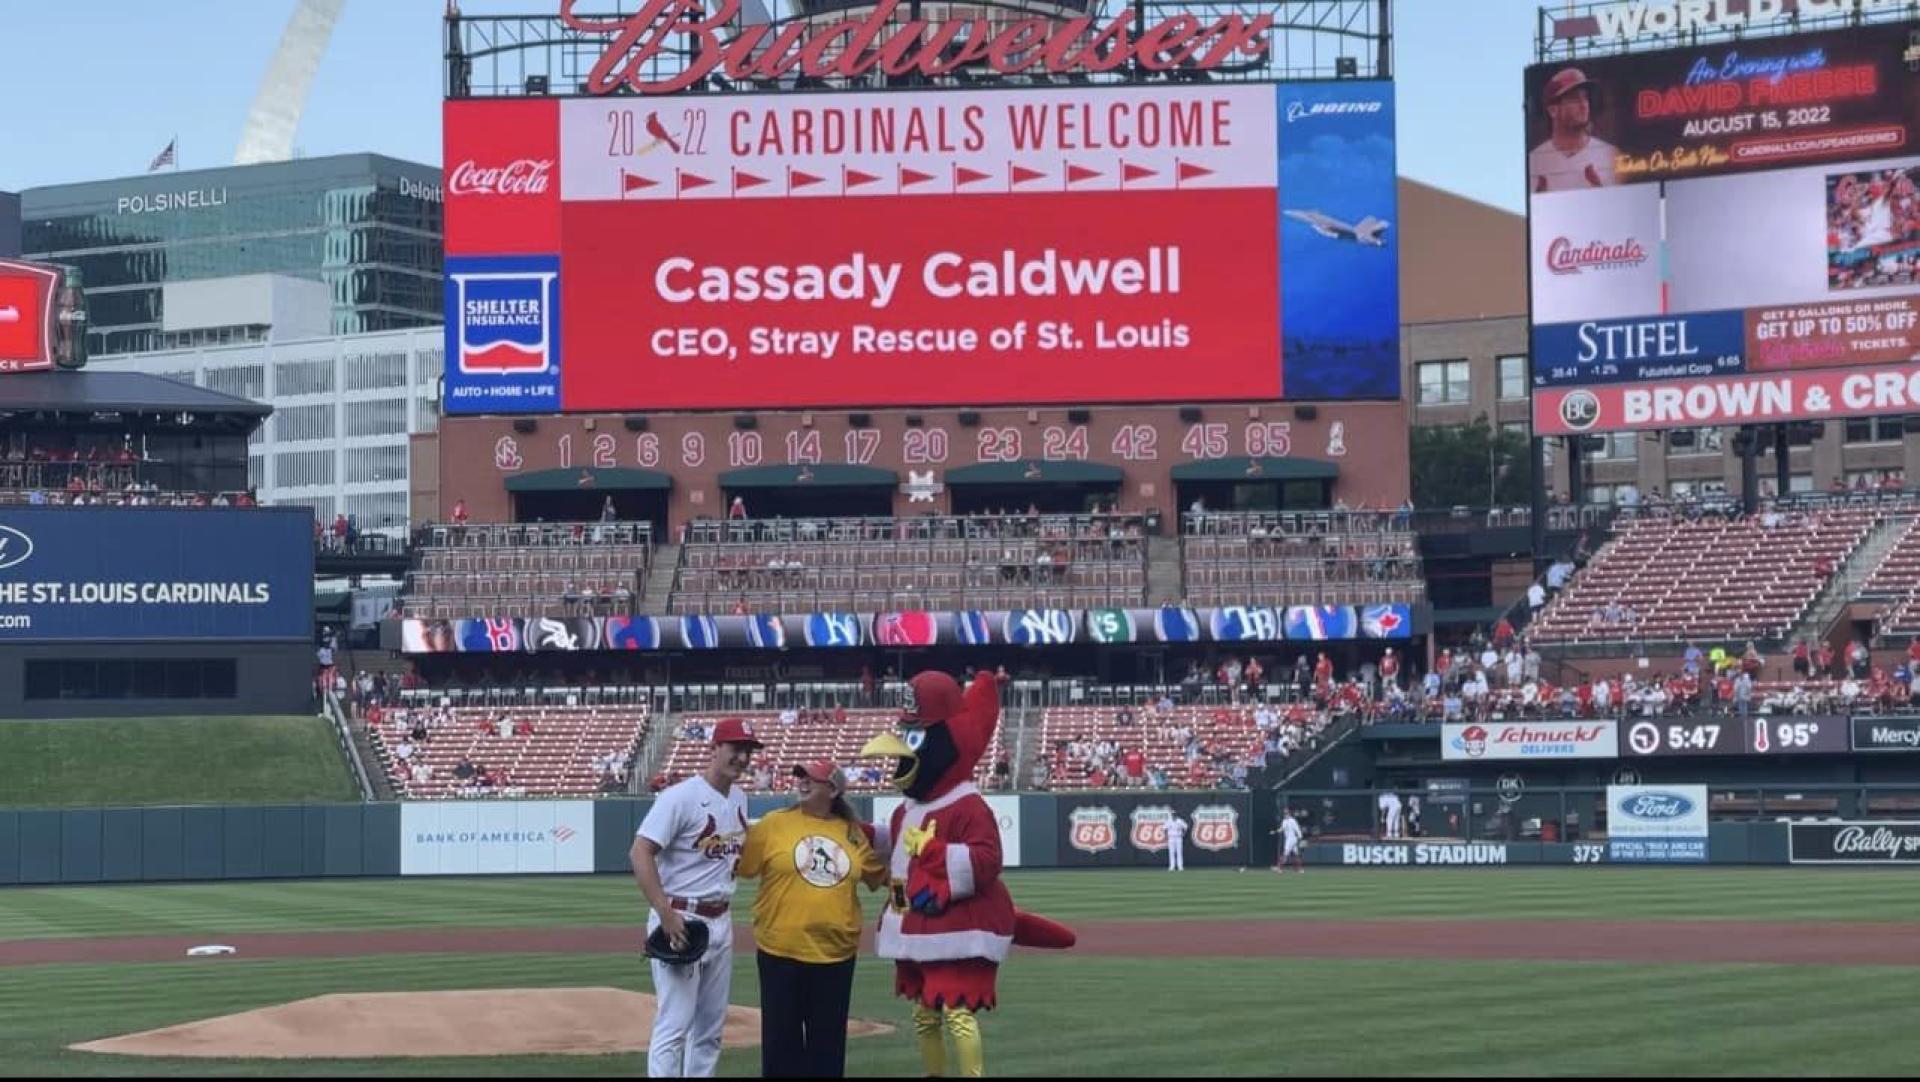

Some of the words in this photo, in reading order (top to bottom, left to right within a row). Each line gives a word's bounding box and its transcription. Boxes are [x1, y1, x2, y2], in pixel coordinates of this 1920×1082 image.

[561, 0, 1272, 94] Budweiser
[1686, 57, 1717, 84] An
[1721, 51, 1786, 85] Evening
[1637, 82, 1741, 117] DAVID
[1749, 65, 1877, 104] FREESE
[1311, 101, 1382, 113] BOEING
[608, 110, 634, 157] 20
[683, 108, 707, 155] 22
[730, 105, 986, 154] CARDINALS
[1008, 100, 1232, 149] WELCOME
[1683, 114, 1753, 137] AUGUST
[1760, 111, 1781, 129] 15,
[1787, 106, 1831, 126] 2022
[450, 159, 555, 194] Coca-Cola
[117, 187, 228, 216] POLSINELLI
[1548, 237, 1648, 275] Cardinals
[655, 253, 901, 308] Cassady
[922, 246, 1180, 298] Caldwell
[465, 299, 540, 315] SHELTER
[1762, 309, 1784, 320] GET
[1798, 305, 1852, 318] GALLONS
[465, 313, 541, 327] INSURANCE
[1757, 322, 1788, 340] GET
[1793, 320, 1815, 337] UP
[1819, 318, 1841, 335] TO
[1846, 315, 1882, 334] 50%
[1886, 311, 1918, 330] OFF
[651, 327, 738, 360] CEO,
[749, 325, 840, 358] Stray
[853, 324, 978, 352] Rescue
[990, 320, 1028, 350] of
[1037, 320, 1082, 350] St.
[1096, 317, 1190, 348] Louis
[1578, 320, 1699, 361] STIFEL
[452, 385, 481, 397] AUTO
[490, 385, 520, 397] HOME
[531, 384, 555, 397] LIFE
[1624, 380, 1793, 424] BROWN
[1804, 385, 1831, 412] &
[560, 435, 571, 468] 1
[594, 435, 617, 468] 2
[638, 433, 659, 467] 6
[682, 432, 704, 466] 9
[728, 432, 762, 466] 10
[785, 431, 821, 465] 14
[845, 430, 880, 464] 17
[903, 429, 949, 463] 20
[978, 427, 1022, 462] 23
[1044, 426, 1089, 460] 24
[1112, 425, 1158, 460] 42
[1182, 423, 1229, 458] 45
[1245, 422, 1291, 457] 85
[32, 583, 65, 603] ST.
[70, 582, 137, 603] LOUIS
[142, 582, 270, 603] CARDINALS
[1494, 726, 1608, 743] Schnucks
[1668, 725, 1721, 748] 5:47
[1778, 723, 1819, 746] 95°
[1871, 727, 1920, 746] Mercy
[1633, 796, 1681, 816] Ford
[416, 834, 453, 843] BANK
[461, 832, 476, 842] OF
[481, 831, 545, 842] AMERICA
[1079, 823, 1106, 842] 66
[1139, 822, 1167, 841] 66
[1200, 822, 1230, 841] 66
[1833, 825, 1903, 858] Bally
[1343, 844, 1408, 864] BUSCH
[1415, 843, 1507, 863] STADIUM
[1573, 844, 1604, 862] 375'
